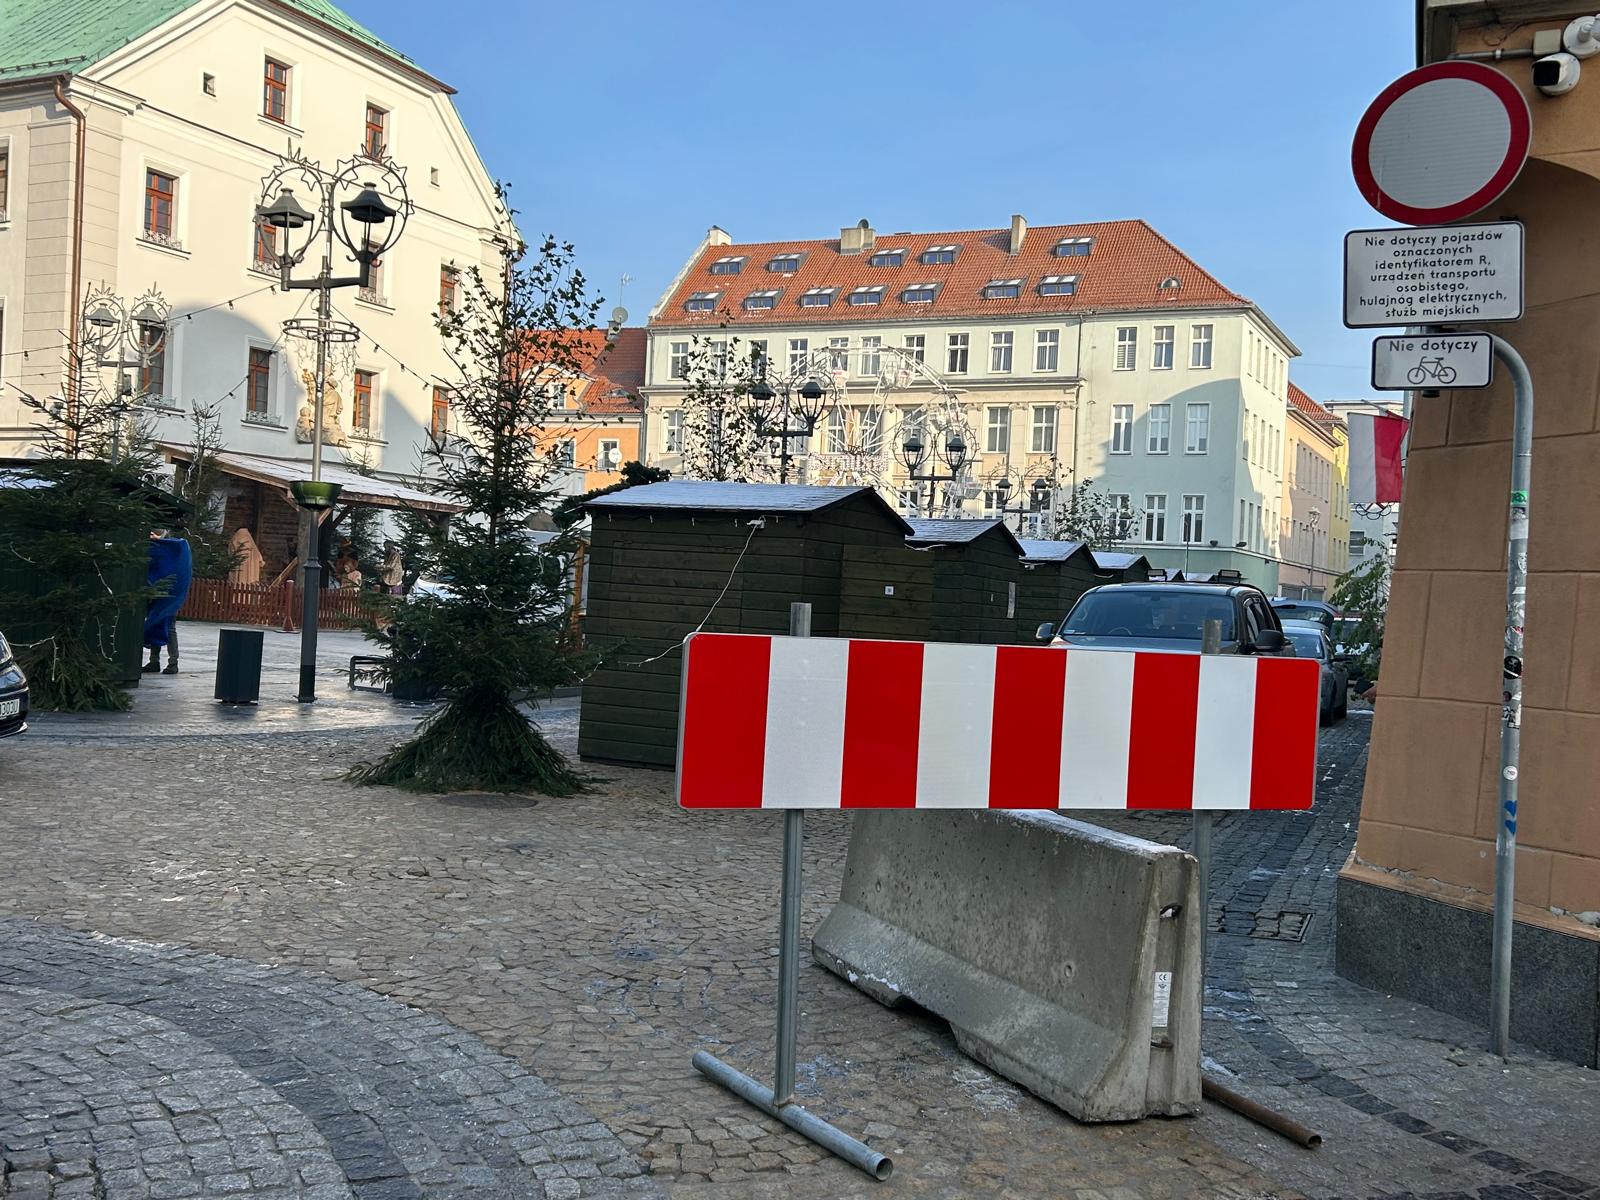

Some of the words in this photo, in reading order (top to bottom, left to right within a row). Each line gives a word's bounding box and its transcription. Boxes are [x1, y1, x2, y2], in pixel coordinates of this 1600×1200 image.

[1365, 237, 1385, 247] Nie
[1390, 235, 1437, 247] dotyczy
[1442, 230, 1503, 245] pojazdów
[1393, 244, 1473, 257] oznaczonych
[1375, 258, 1473, 271] identyfikatorem
[1370, 270, 1425, 283] urządzeń
[1430, 268, 1496, 280] transportu
[1396, 282, 1469, 293] osobistego,
[1359, 293, 1413, 307] hulajnóg
[1418, 290, 1507, 304] elektrycznych,
[1385, 306, 1417, 318] służb
[1422, 305, 1480, 317] miejskich
[1389, 340, 1414, 352] Nie
[1421, 339, 1478, 353] dotyczy
